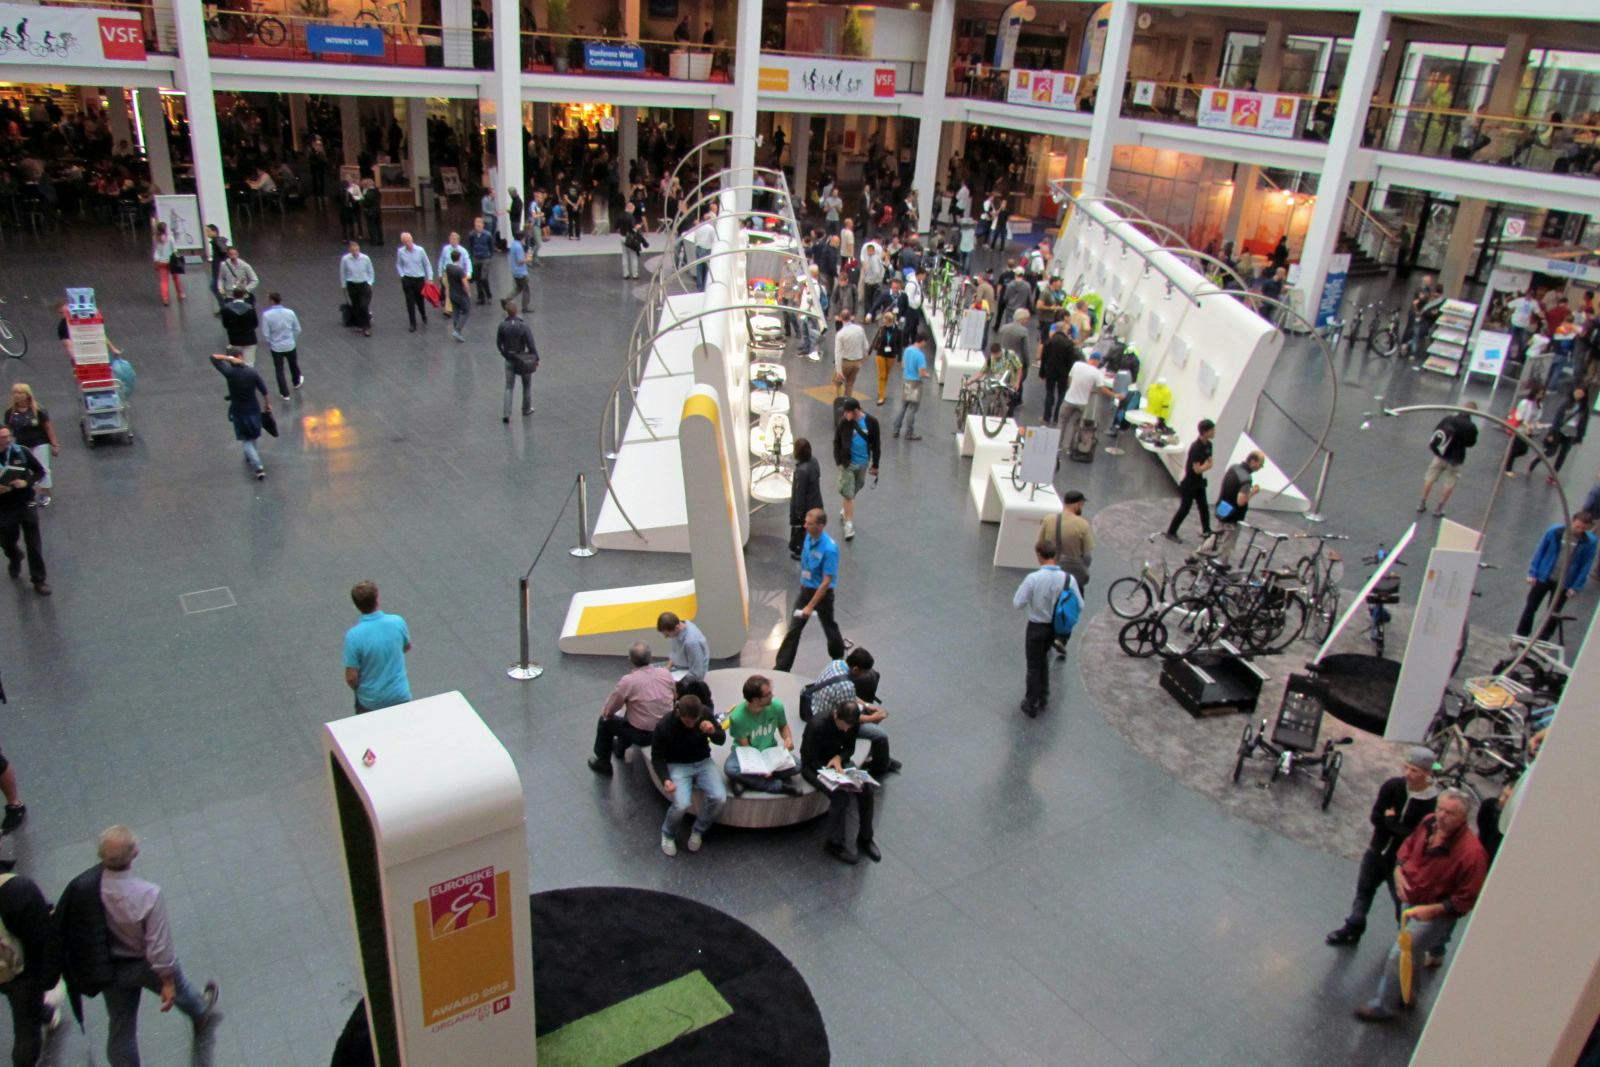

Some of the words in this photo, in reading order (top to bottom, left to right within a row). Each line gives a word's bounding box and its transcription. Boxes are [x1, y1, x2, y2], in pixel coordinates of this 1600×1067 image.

[101, 26, 143, 44] VSF.
[325, 37, 352, 45] INTERNET
[619, 51, 634, 59] West
[589, 58, 621, 67] Conference
[622, 60, 638, 68] West
[876, 74, 894, 86] VSF.
[431, 868, 495, 897] EUROBIKE
[431, 993, 480, 1017] AWARD
